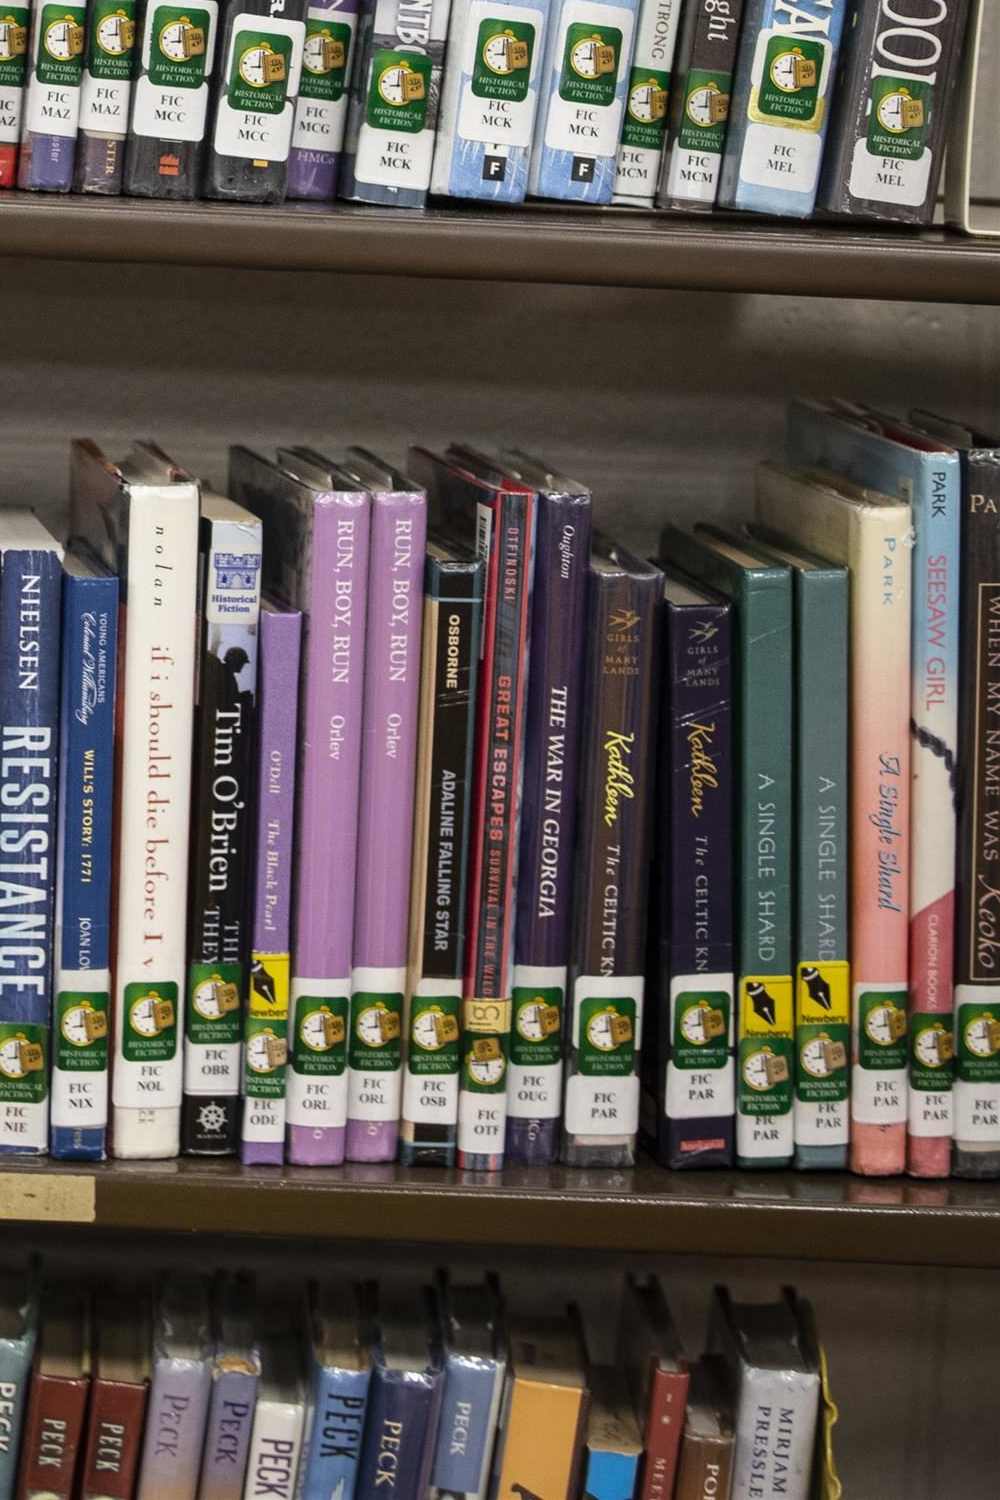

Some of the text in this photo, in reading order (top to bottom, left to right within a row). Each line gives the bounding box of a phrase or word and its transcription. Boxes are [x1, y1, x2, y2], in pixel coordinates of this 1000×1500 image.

[768, 159, 796, 174] MEL
[773, 144, 796, 158] FIC
[930, 470, 946, 519] PARK
[18, 575, 41, 691] NIELSEN
[211, 595, 256, 605] Historical
[218, 604, 251, 613] Fiction
[330, 519, 355, 683] RUN, BOY, RUN
[923, 554, 948, 712] SEESAW GIRL
[447, 614, 461, 689] OSBORNE
[327, 716, 346, 761] Orlev
[208, 703, 244, 892] Tim O'Brien
[604, 730, 638, 829] Kathleen
[80, 749, 96, 884] WILL'S STORY: 1771
[434, 769, 456, 951] ADALINE FALLING STAR
[757, 774, 775, 962] A SINGLE SHARD
[688, 1089, 715, 1100] PAR
[691, 1075, 712, 1085] FIC
[320, 1395, 364, 1459] PECK
[375, 1420, 402, 1487] PECK
[453, 1401, 471, 1456] PECK
[772, 1408, 795, 1496] MIRJAM
